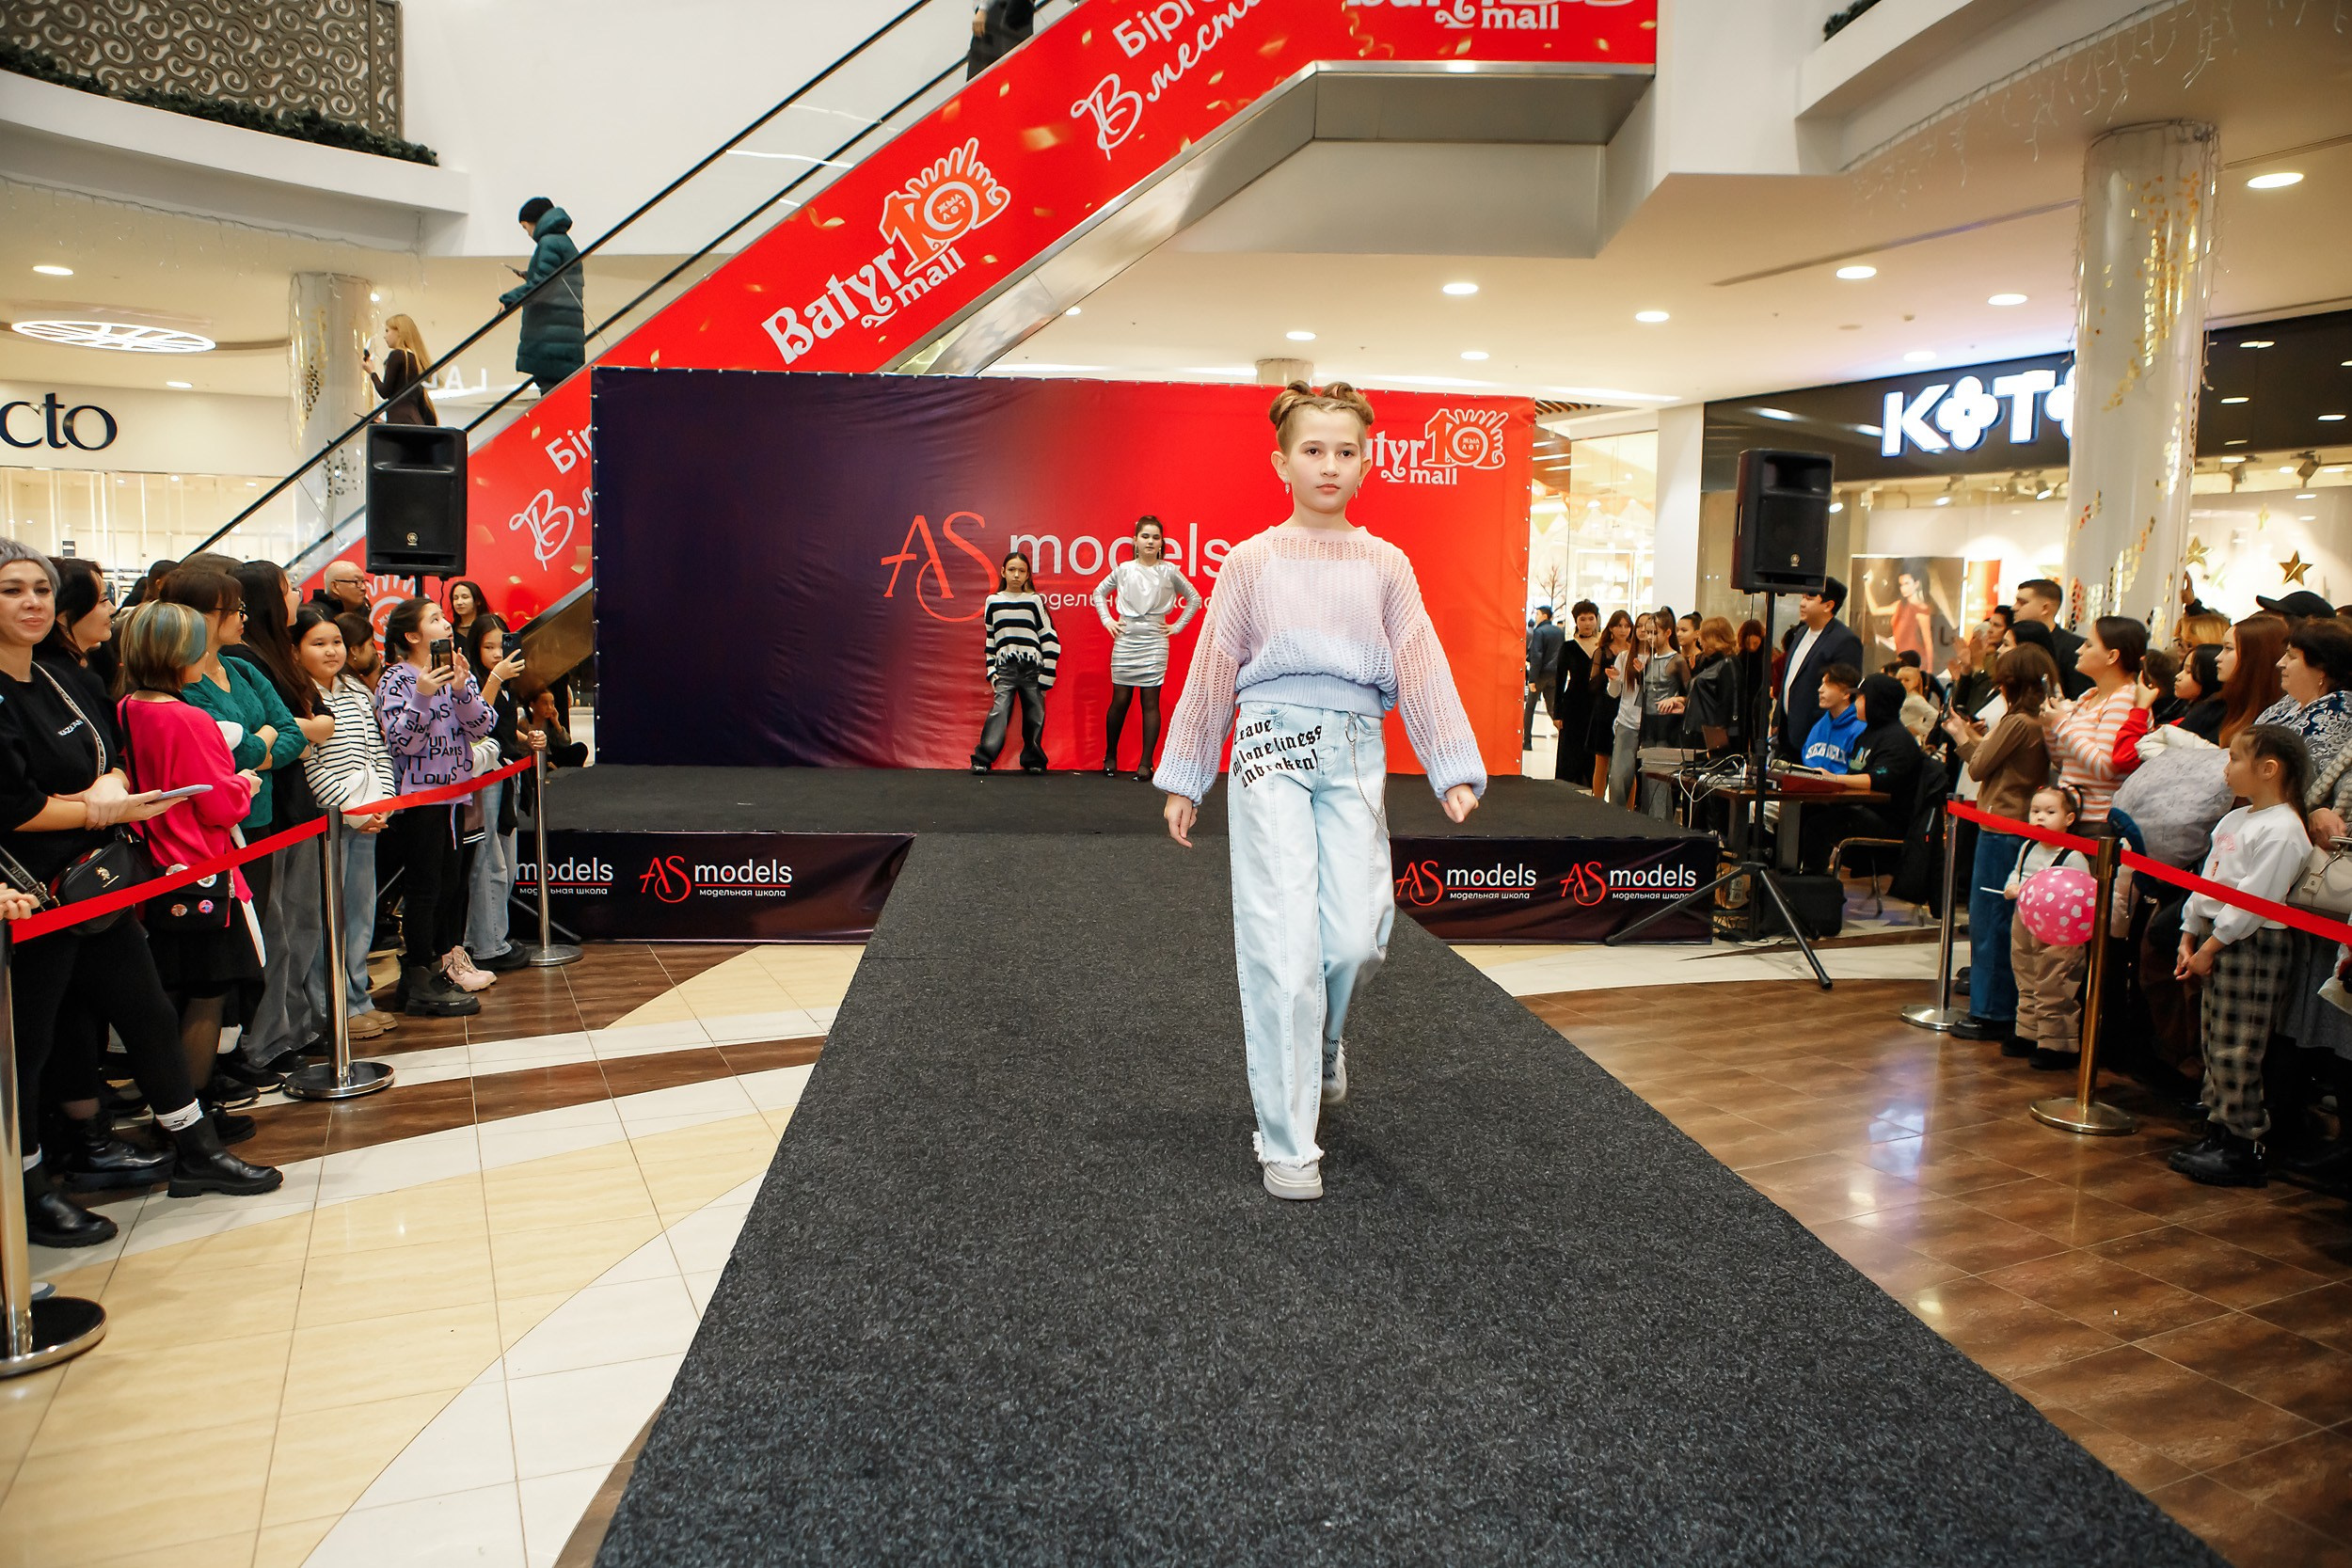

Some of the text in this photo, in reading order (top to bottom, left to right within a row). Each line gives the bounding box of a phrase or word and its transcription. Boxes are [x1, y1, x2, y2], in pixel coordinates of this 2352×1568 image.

[1481, 5, 1560, 29] mall
[896, 246, 966, 307] mall
[761, 247, 902, 365] Batyr
[0, 392, 118, 451] cto
[1409, 468, 1457, 485] mall
[881, 511, 1000, 623] AS
[429, 747, 463, 760] PARIS
[411, 767, 457, 785] LOUIS
[640, 855, 793, 904] AS models
[699, 889, 753, 898] модельная
[1395, 860, 1537, 907] AS models
[1450, 892, 1531, 901] модельная школа
[1560, 861, 1696, 907] AS models
[1613, 892, 1661, 901] модельная
